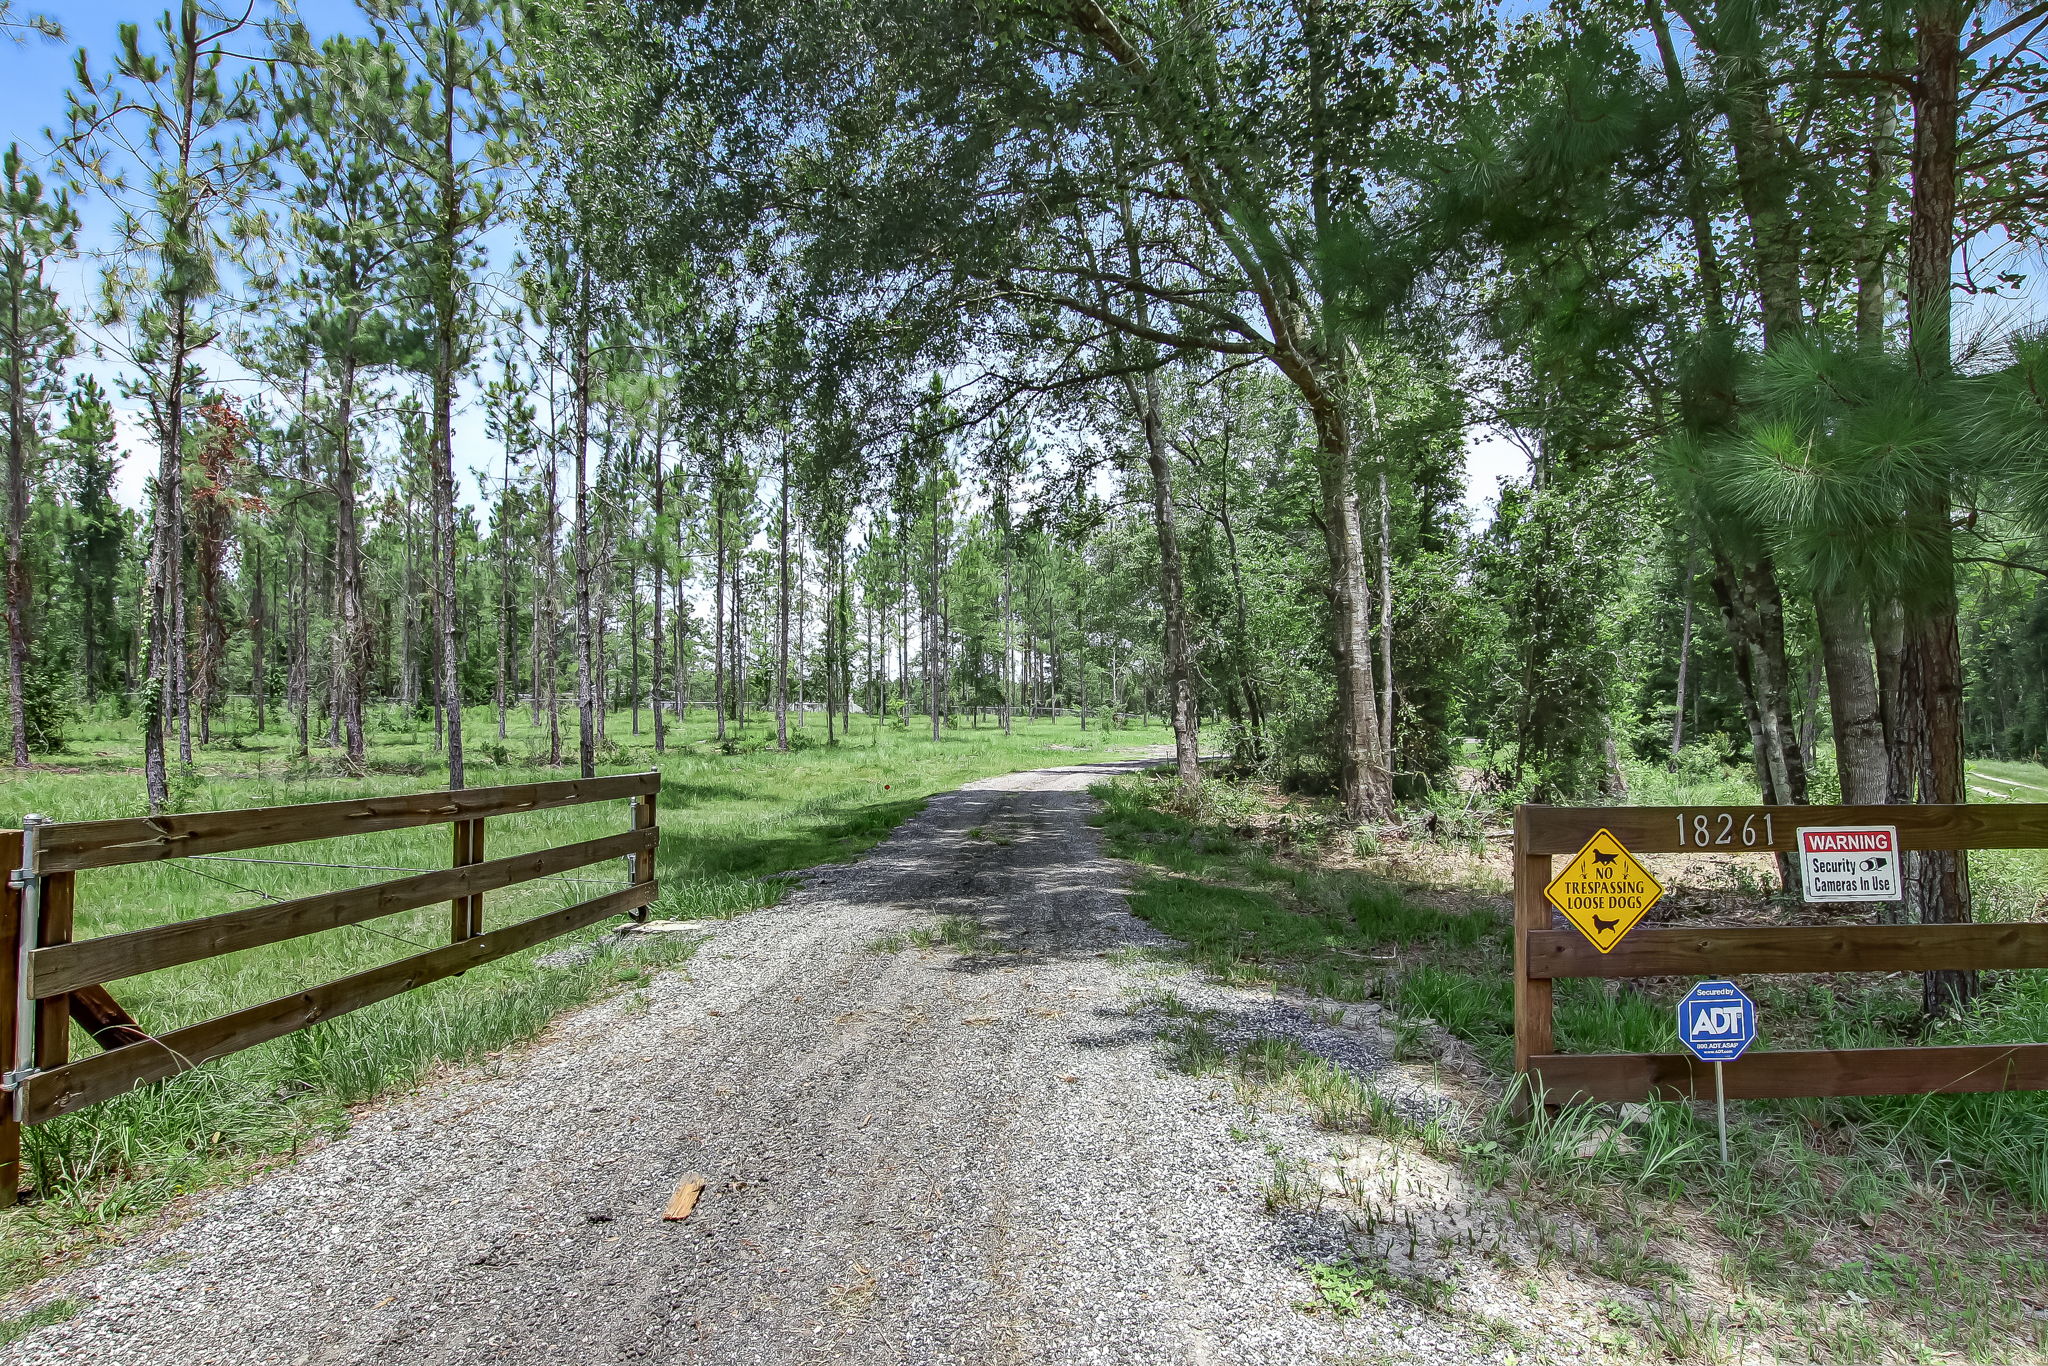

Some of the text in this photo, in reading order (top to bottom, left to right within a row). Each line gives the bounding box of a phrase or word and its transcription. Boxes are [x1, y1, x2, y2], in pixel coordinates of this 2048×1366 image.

[1676, 813, 1774, 847] 18261
[1808, 834, 1888, 850] WARNING
[1595, 867, 1613, 880] NO
[1812, 858, 1856, 875] Security
[1565, 881, 1644, 895] TRESPASSING
[1814, 877, 1858, 892] Cameras
[1860, 876, 1870, 891] In
[1872, 876, 1890, 891] Use
[1567, 896, 1642, 910] LOOSE DOGS
[1725, 988, 1734, 996] by
[1691, 1006, 1743, 1036] ADT
